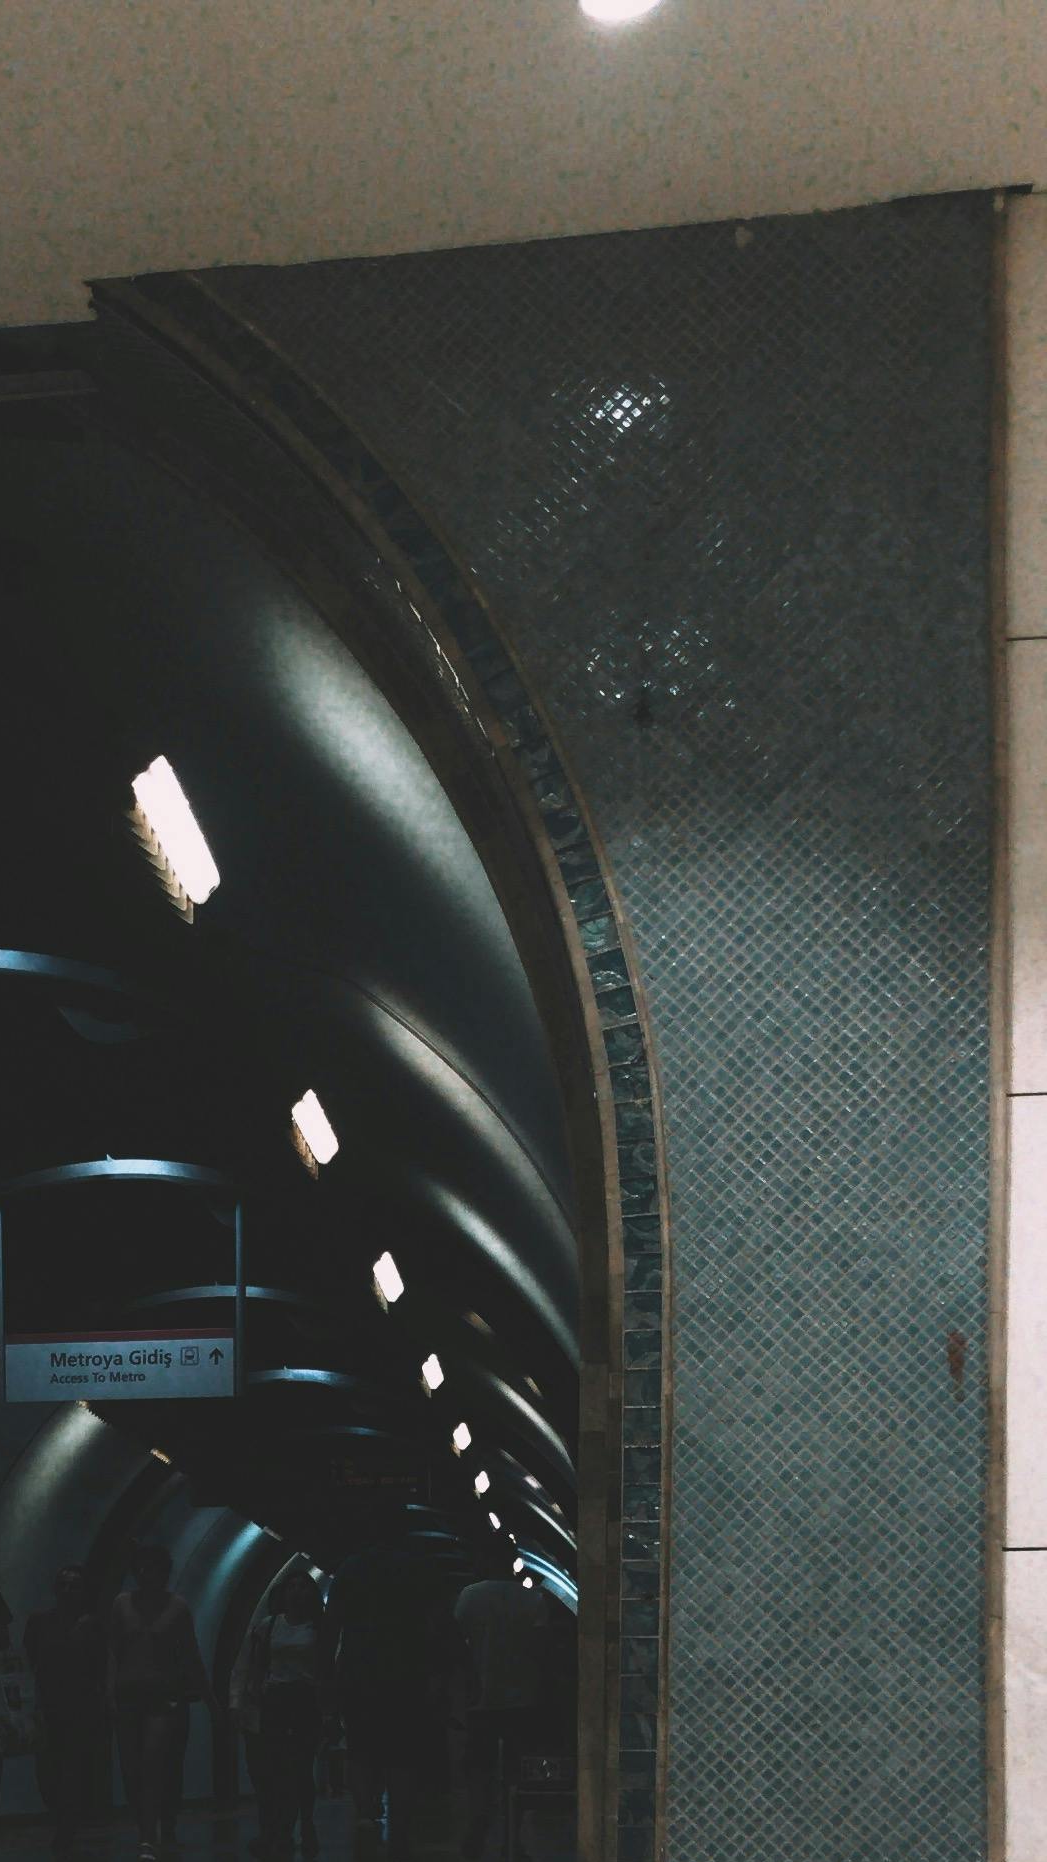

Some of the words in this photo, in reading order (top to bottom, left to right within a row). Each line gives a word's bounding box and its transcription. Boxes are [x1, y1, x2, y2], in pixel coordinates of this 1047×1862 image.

[50, 1352, 123, 1370] Metroya
[128, 1349, 172, 1368] Gidiş
[49, 1374, 90, 1385] Access
[92, 1373, 106, 1384] To
[109, 1372, 146, 1383] Metro
